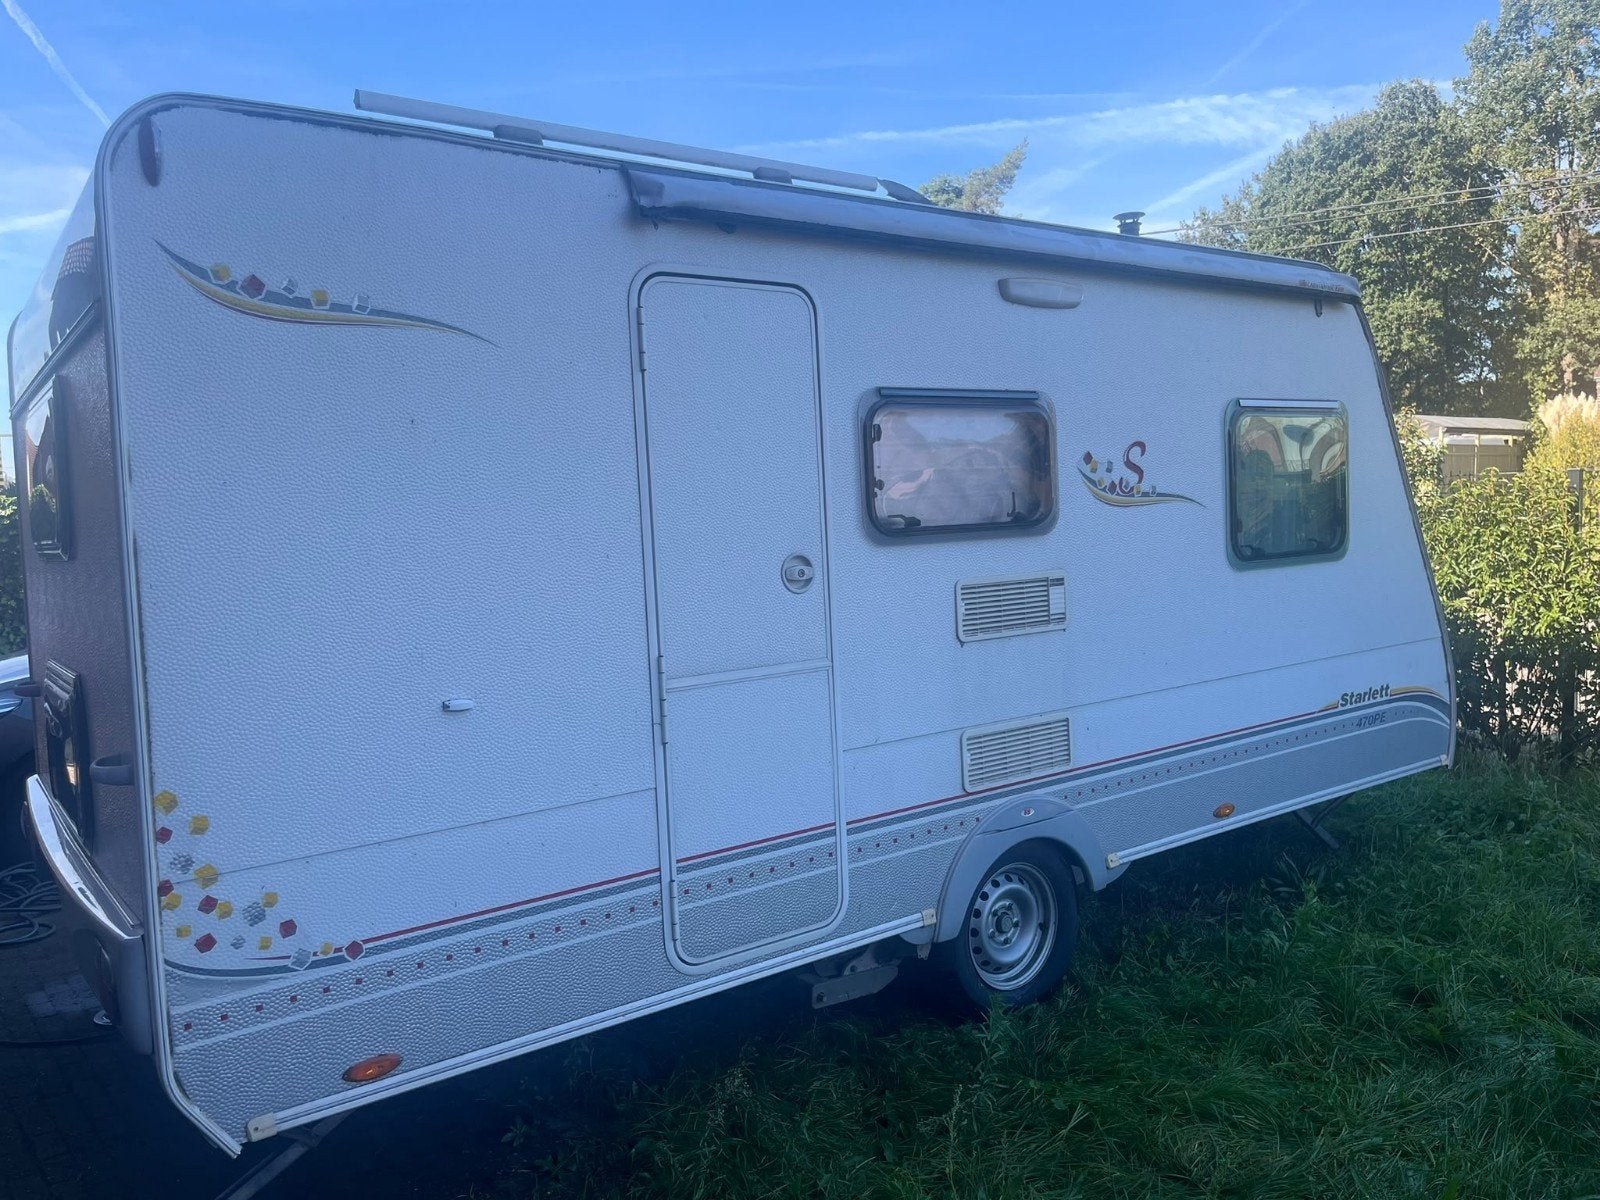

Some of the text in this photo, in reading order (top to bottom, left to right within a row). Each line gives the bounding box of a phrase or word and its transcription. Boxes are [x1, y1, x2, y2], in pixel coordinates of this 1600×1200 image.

[1119, 441, 1146, 495] S
[1340, 684, 1390, 707] Starlett
[1356, 712, 1387, 728] 470PE
